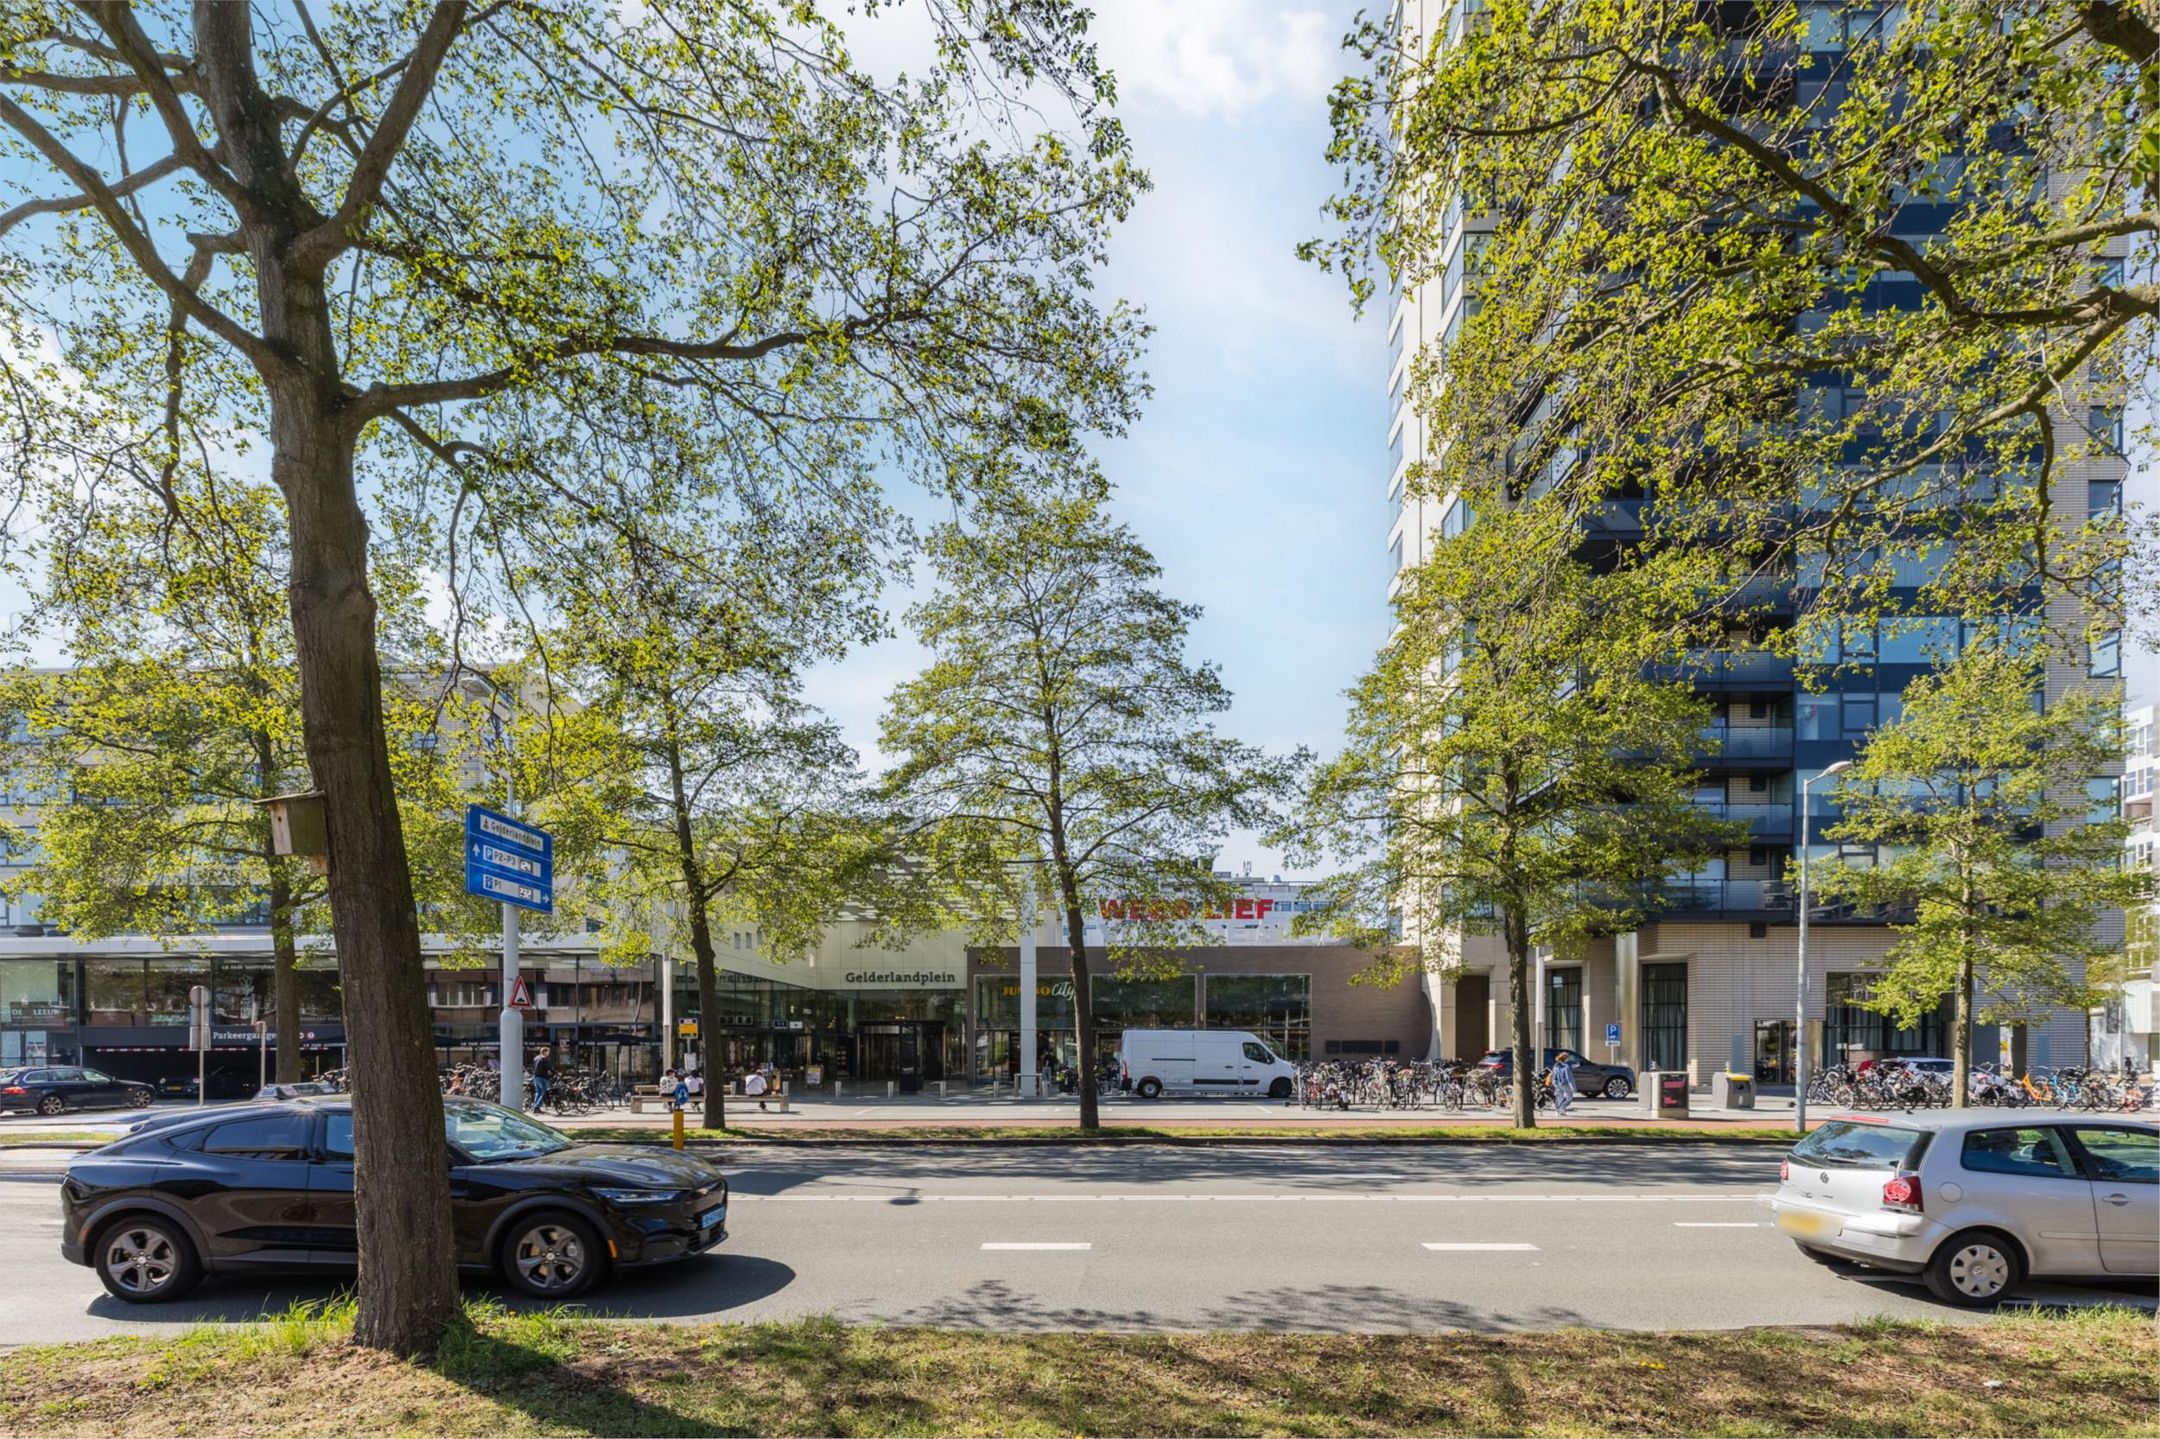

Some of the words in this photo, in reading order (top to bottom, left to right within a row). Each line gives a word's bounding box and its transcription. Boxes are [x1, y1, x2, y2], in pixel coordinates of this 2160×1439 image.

[491, 821, 541, 848] Gelderlandplein
[1203, 899, 1274, 920] LIEF
[845, 971, 956, 985] Gelderlandplein
[1002, 985, 1051, 996] JUO
[12, 1008, 24, 1016] DE
[33, 1008, 61, 1016] LEEUW
[1610, 1025, 1617, 1035] P
[213, 1031, 277, 1041] Parkeergarge
